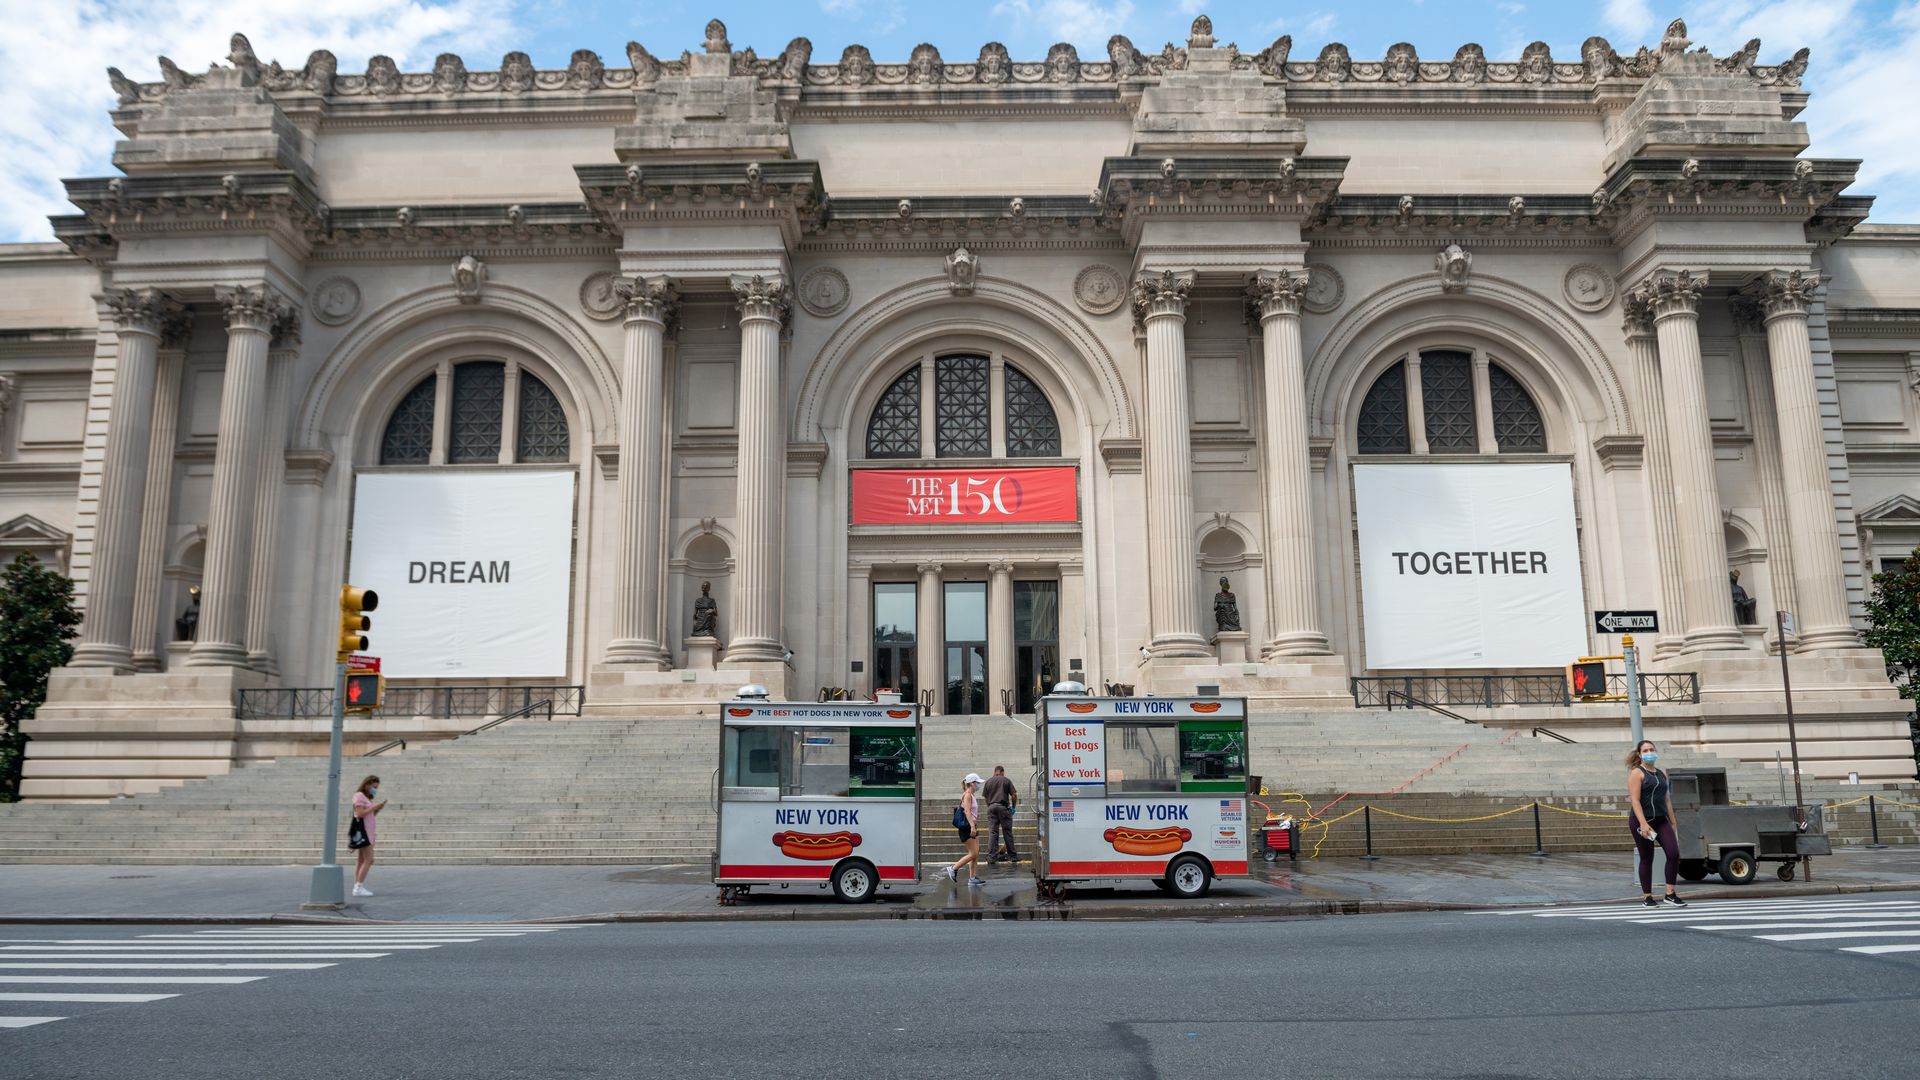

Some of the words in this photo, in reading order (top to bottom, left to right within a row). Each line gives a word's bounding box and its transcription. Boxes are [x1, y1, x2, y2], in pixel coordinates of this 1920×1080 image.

[906, 477, 943, 496] THE
[946, 476, 1023, 515] 150
[906, 497, 944, 515] MET
[1391, 551, 1548, 575] TOGETHER
[408, 560, 511, 584] DREAM
[1604, 617, 1623, 627] ONE
[1630, 617, 1650, 627] WAY
[862, 710, 883, 718] YORK
[1114, 701, 1141, 714] NEW
[1143, 701, 1174, 714] YORK
[1065, 727, 1087, 737] Best
[1053, 741, 1072, 750] Hot
[1074, 741, 1099, 752] Dogs
[1071, 754, 1081, 764] in
[1052, 769, 1076, 778] New
[1077, 769, 1101, 778] York
[775, 809, 811, 825] NEW
[816, 809, 859, 825] YORK
[1105, 804, 1142, 821] NEW
[1145, 804, 1189, 821] YORK
